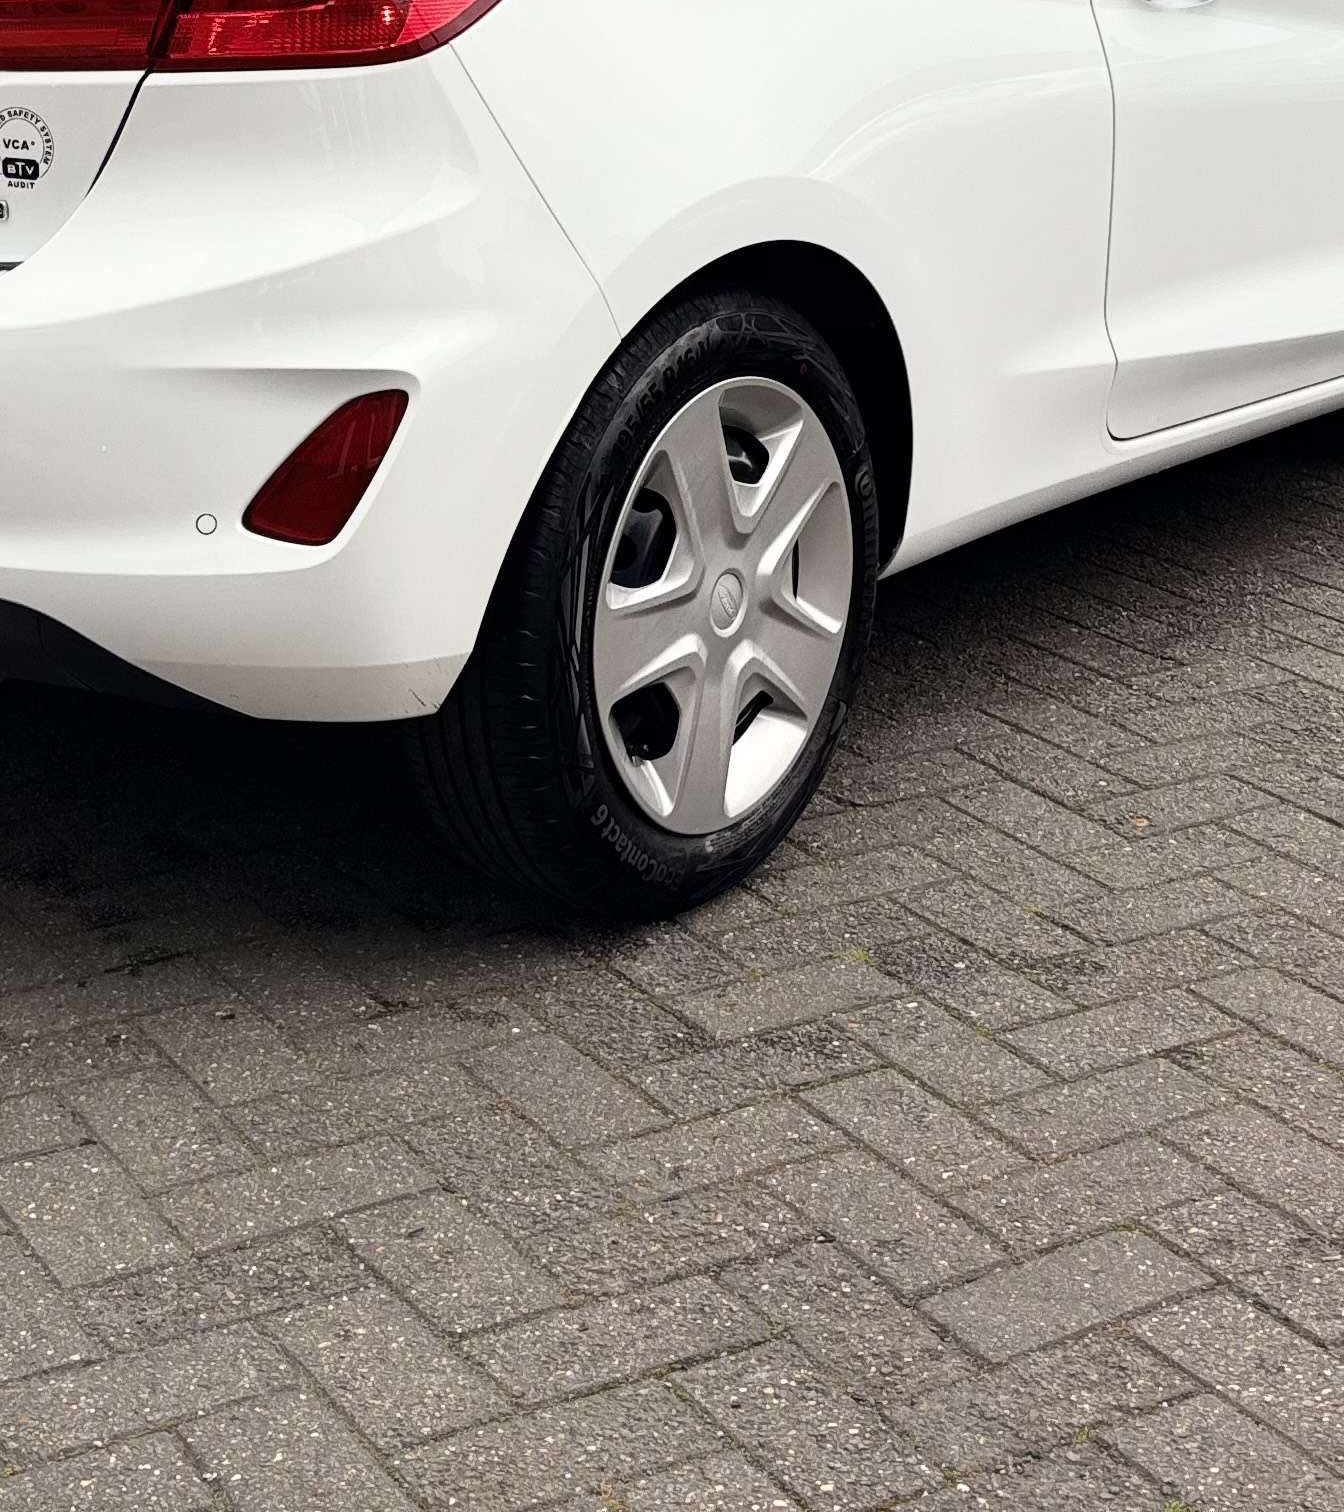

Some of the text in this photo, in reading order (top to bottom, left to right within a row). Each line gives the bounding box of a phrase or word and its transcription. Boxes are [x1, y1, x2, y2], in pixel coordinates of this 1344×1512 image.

[7, 109, 41, 125] SAFETY
[40, 125, 53, 165] SYSTEM
[7, 180, 35, 189] AUDIT
[590, 803, 609, 827] 6
